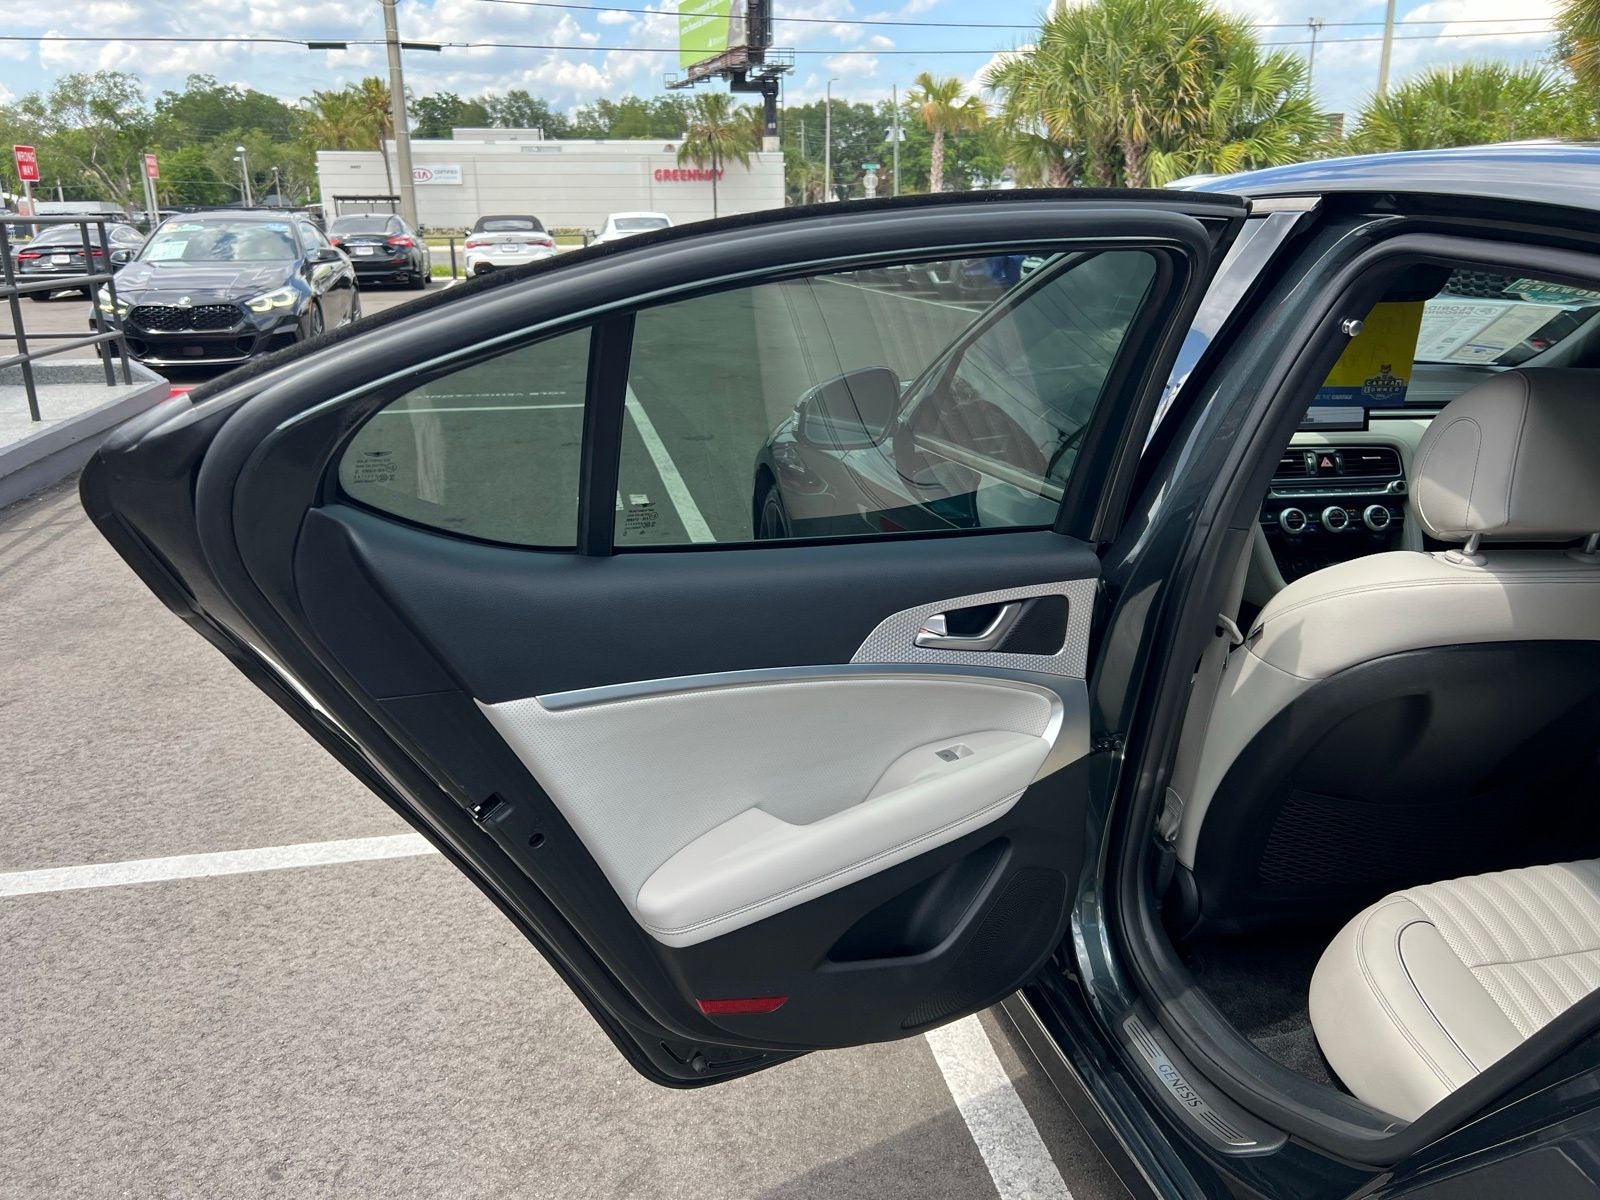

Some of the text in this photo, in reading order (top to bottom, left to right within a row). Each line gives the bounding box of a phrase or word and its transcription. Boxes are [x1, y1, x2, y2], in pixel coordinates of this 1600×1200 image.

[16, 151, 34, 162] WRONG
[22, 165, 34, 175] WAY
[1159, 1064, 1203, 1108] GENESIS
